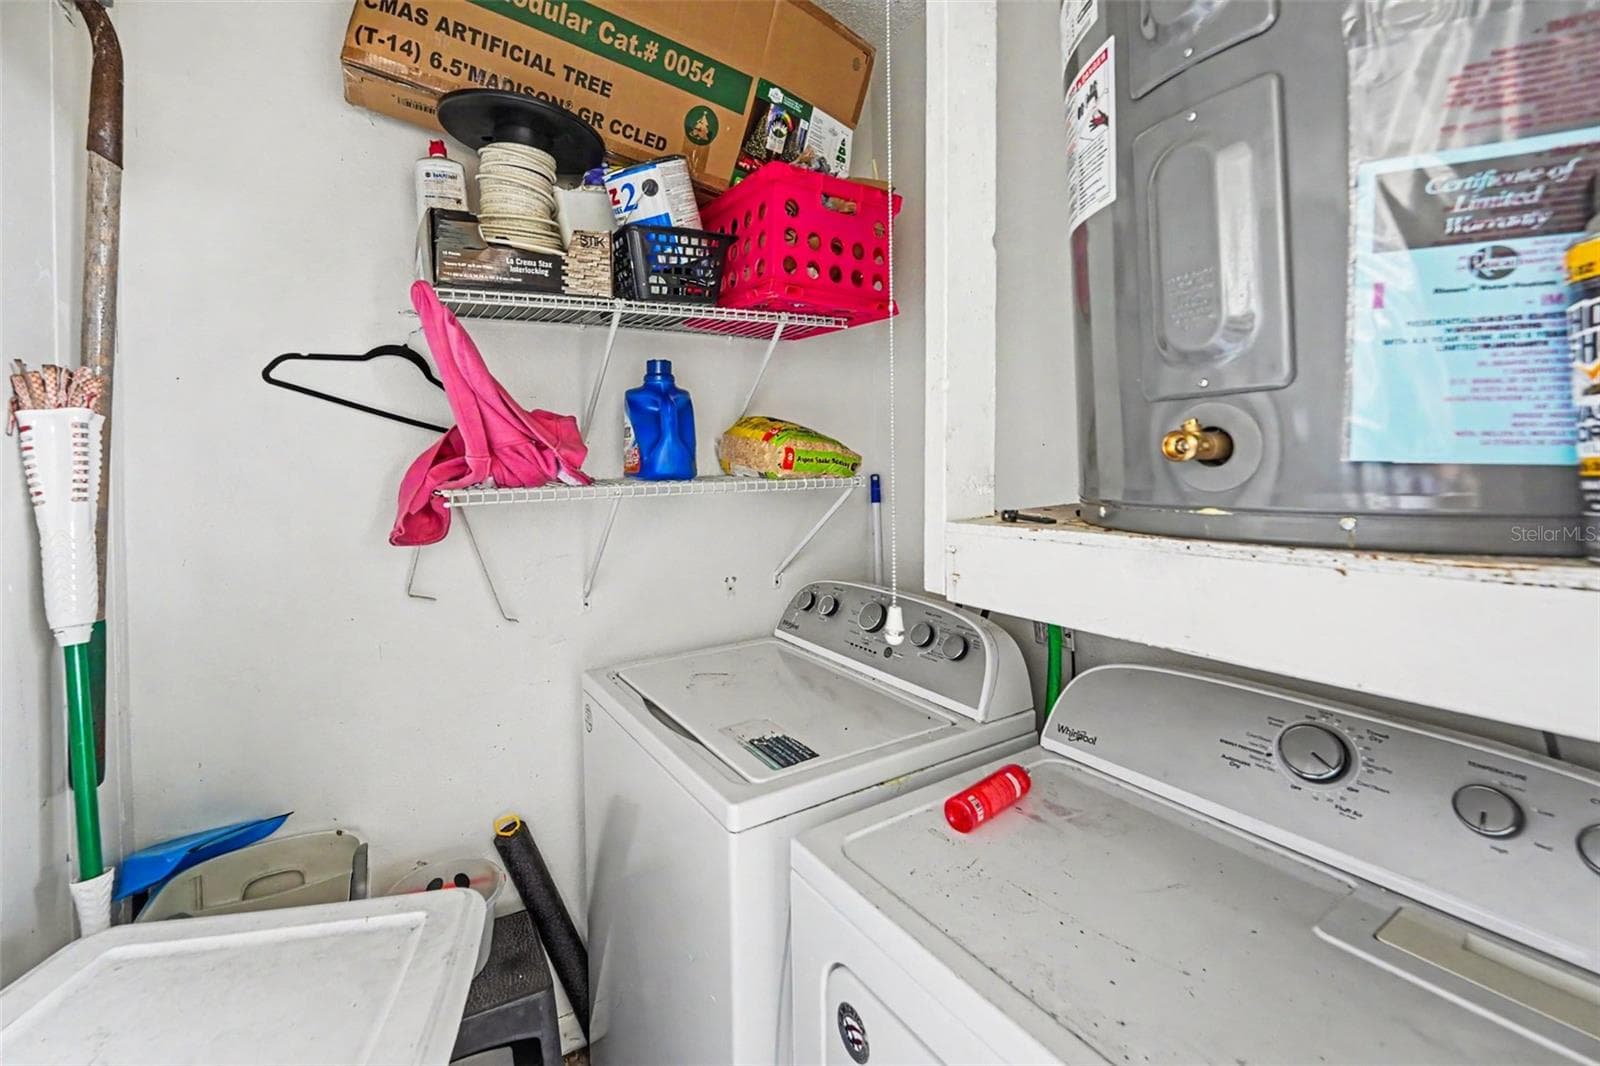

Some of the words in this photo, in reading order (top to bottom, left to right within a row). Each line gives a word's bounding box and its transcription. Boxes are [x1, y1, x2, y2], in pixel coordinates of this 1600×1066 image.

[435, 16, 556, 77] ARTIFICIAL
[563, 65, 613, 98] TREE
[598, 20, 659, 64] Cat.#
[664, 49, 716, 88] 0054
[355, 24, 421, 64] (T-14)
[577, 107, 605, 129] GR
[609, 119, 667, 151] CCLED
[1549, 157, 1583, 182] of
[620, 183, 639, 213] 2
[1452, 185, 1545, 213] Limited
[509, 265, 550, 278] Interlocking
[1057, 724, 1098, 746] Whirlpool
